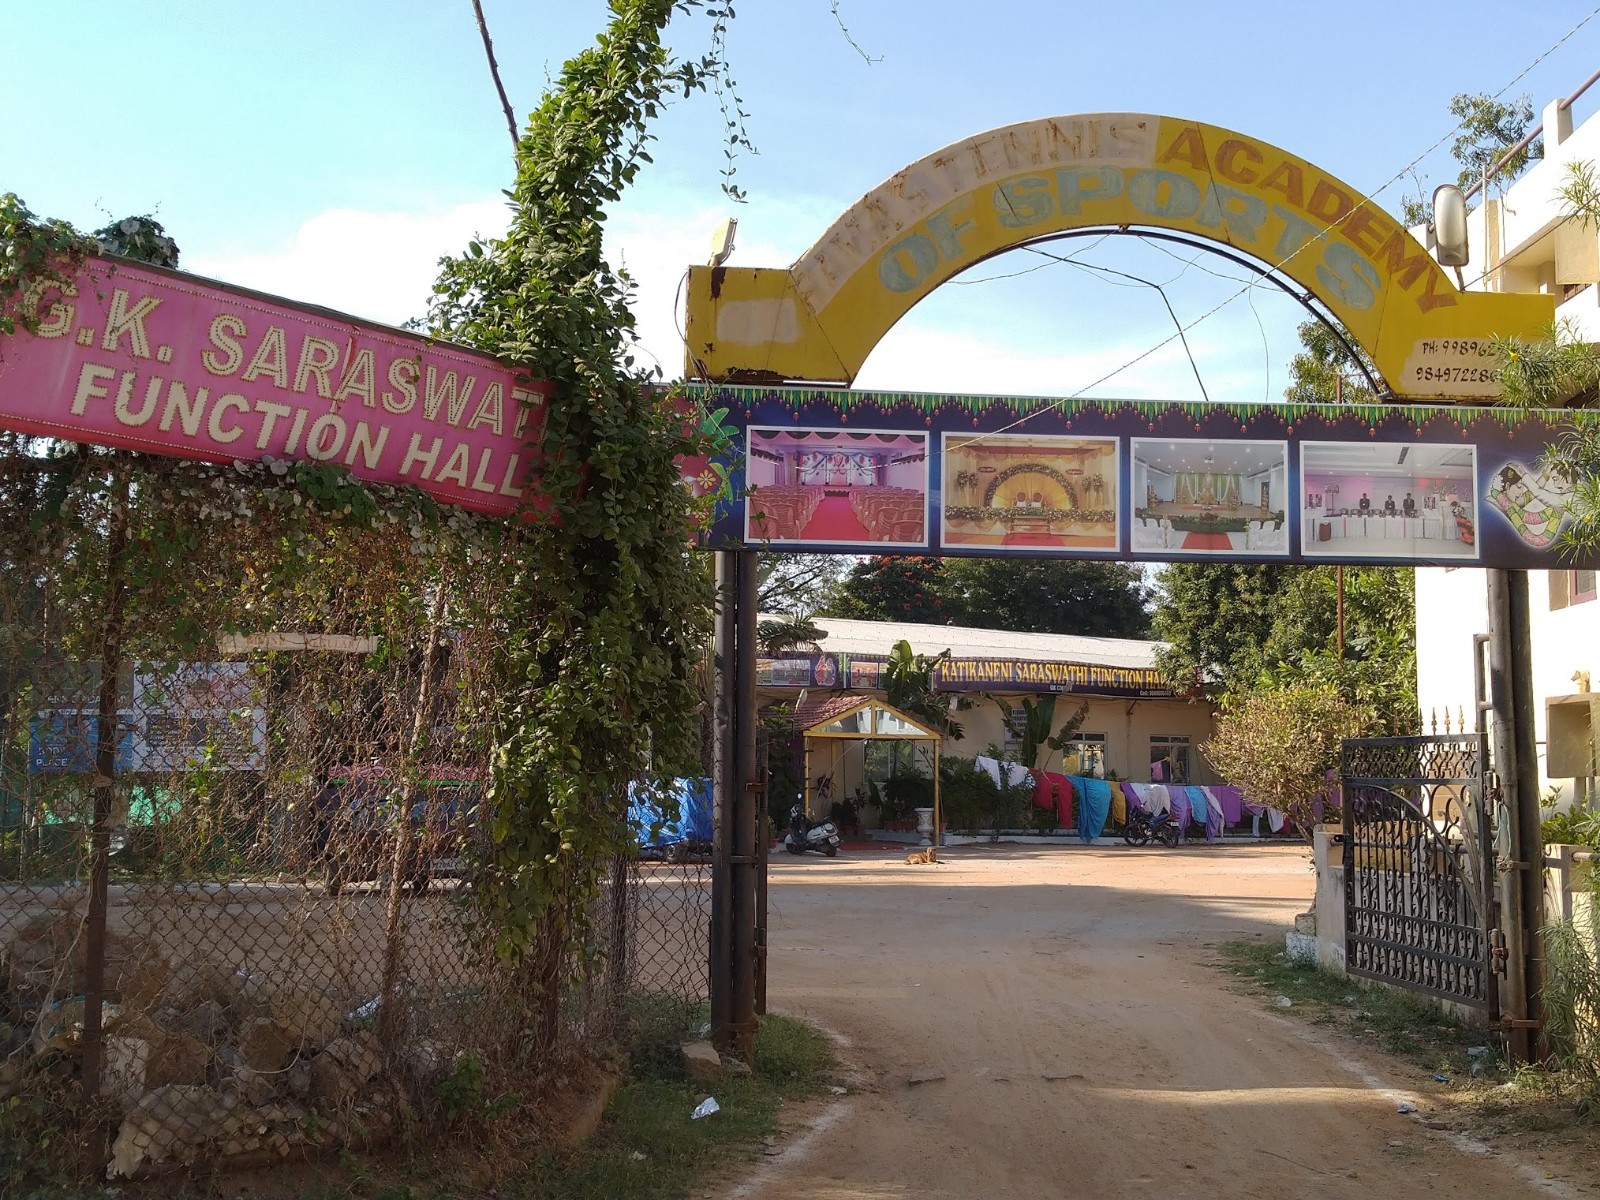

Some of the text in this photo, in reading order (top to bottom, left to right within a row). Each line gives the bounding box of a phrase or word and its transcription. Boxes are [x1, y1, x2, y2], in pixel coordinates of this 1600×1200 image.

[878, 192, 978, 294] OF
[993, 164, 1382, 312] SPORTS
[1158, 126, 1458, 314] ACADEMY
[23, 274, 551, 443] G.K. SARASWAT
[1422, 340, 1439, 355] PH:
[69, 361, 523, 497] FUNCTION HALL
[941, 660, 1014, 682] KATIKANENI
[1016, 661, 1088, 686] SARASWATHI
[1090, 666, 1143, 689] FUNCTION
